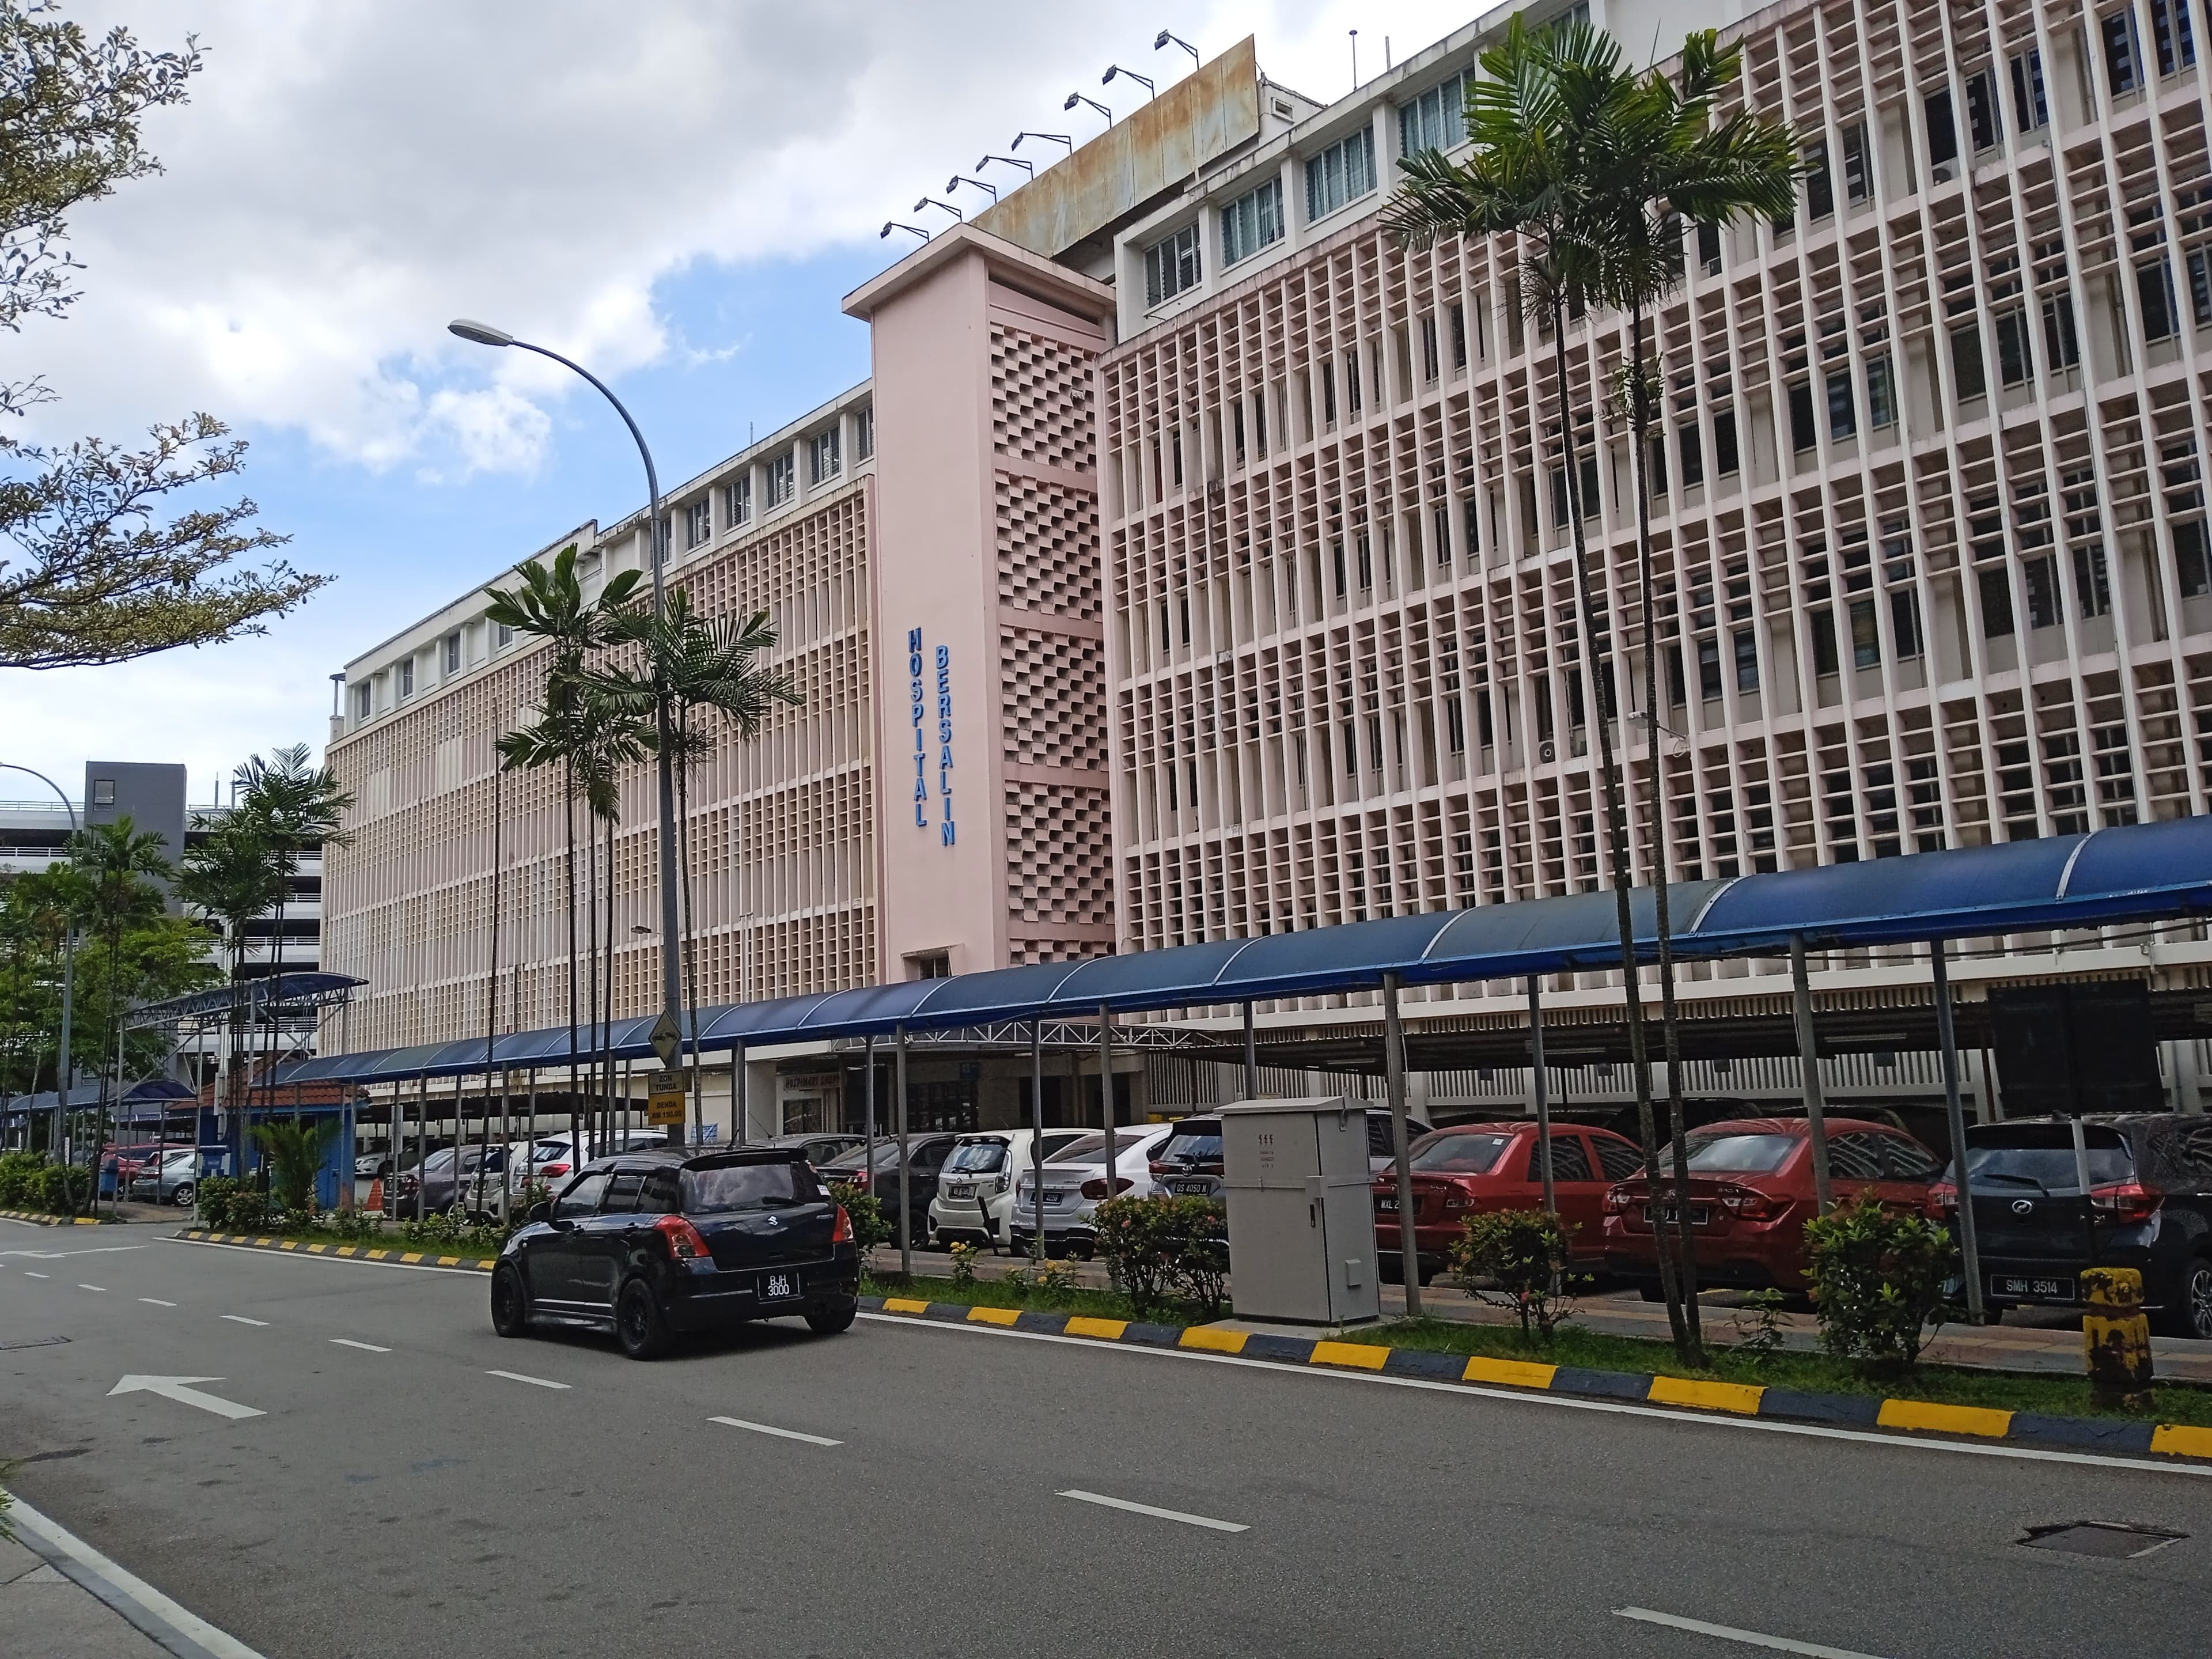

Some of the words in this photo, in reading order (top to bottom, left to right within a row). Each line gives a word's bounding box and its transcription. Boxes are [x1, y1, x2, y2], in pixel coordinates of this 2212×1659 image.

[908, 626, 927, 827] HOSPITAL
[935, 645, 955, 847] BERSALIN
[658, 1074, 672, 1082] ZON
[655, 1083, 677, 1091] TUNDA
[657, 1101, 677, 1109] DENDA
[1185, 1184, 1200, 1192] 4050
[770, 1274, 787, 1286] BJH
[767, 1283, 790, 1296] 3000
[2006, 1279, 2028, 1292] SMH
[2033, 1281, 2058, 1294] 3514
